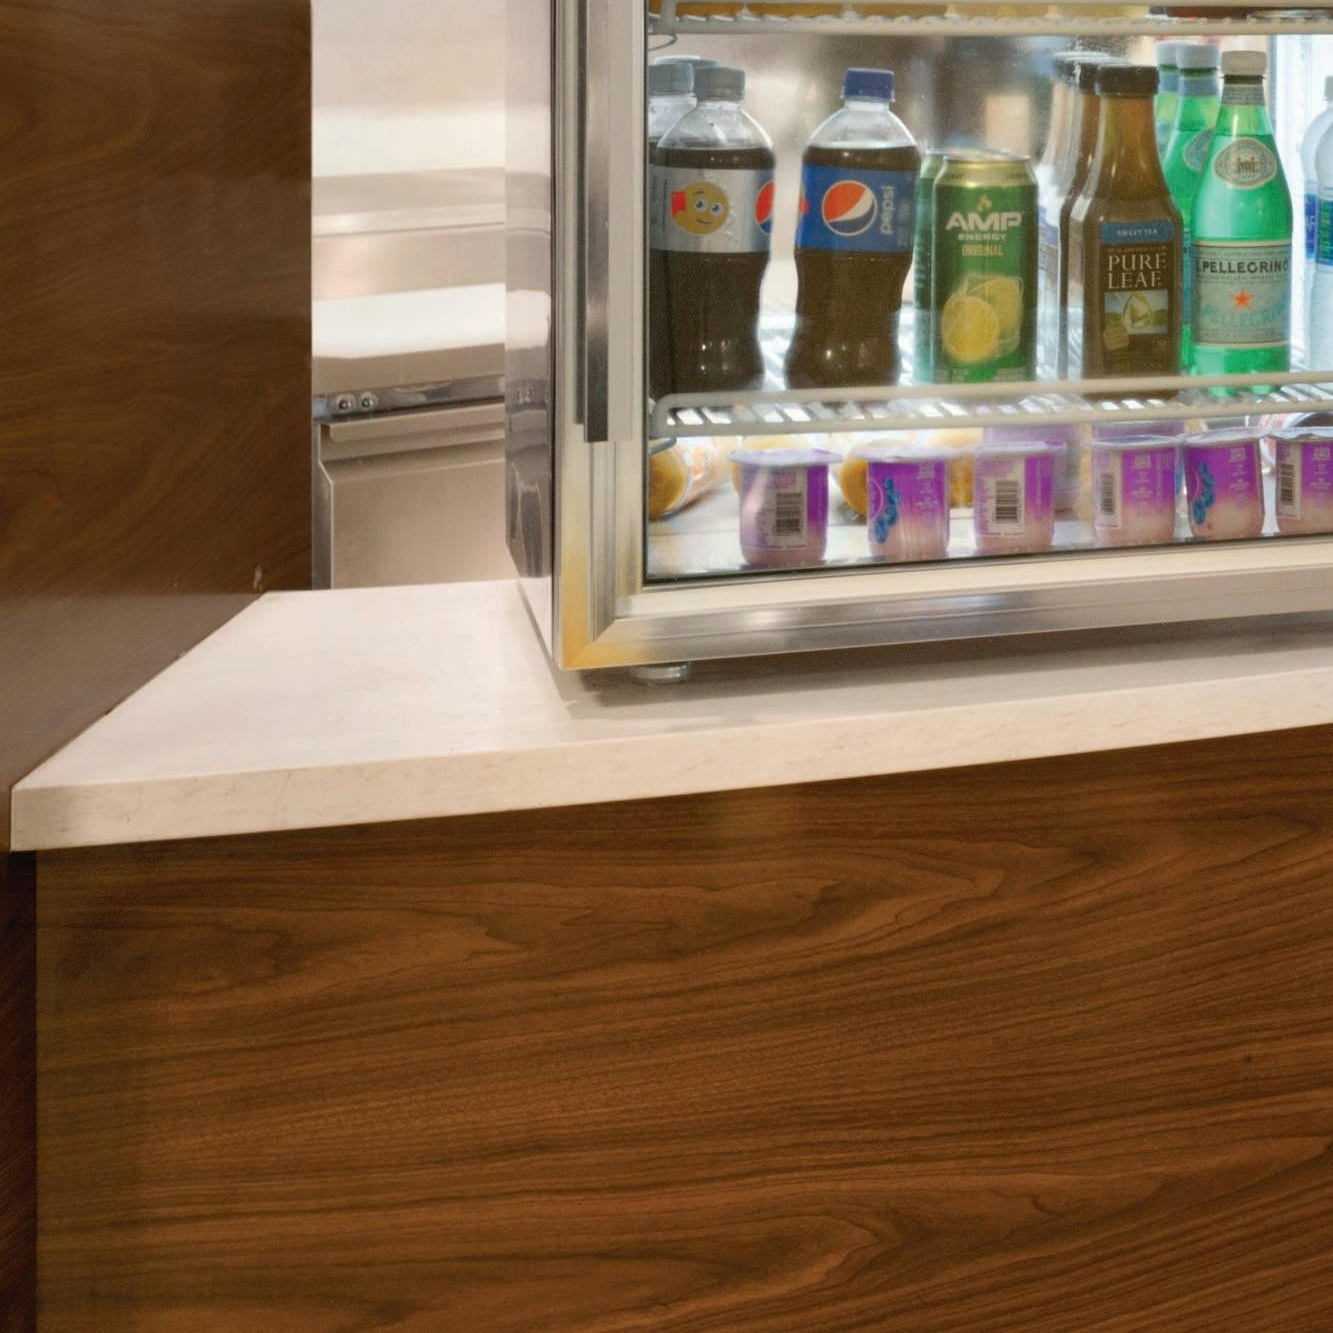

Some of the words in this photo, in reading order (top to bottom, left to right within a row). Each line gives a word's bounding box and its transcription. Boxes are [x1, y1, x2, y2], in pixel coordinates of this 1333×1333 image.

[881, 186, 895, 235] pepsi
[945, 212, 1023, 232] AMP
[958, 233, 1007, 241] ENERGY
[1117, 229, 1141, 237] SWEET
[1143, 228, 1158, 236] TEA
[962, 244, 1004, 256] ORIGINAL
[1108, 254, 1167, 272] PURE
[1108, 271, 1162, 290] LEAF
